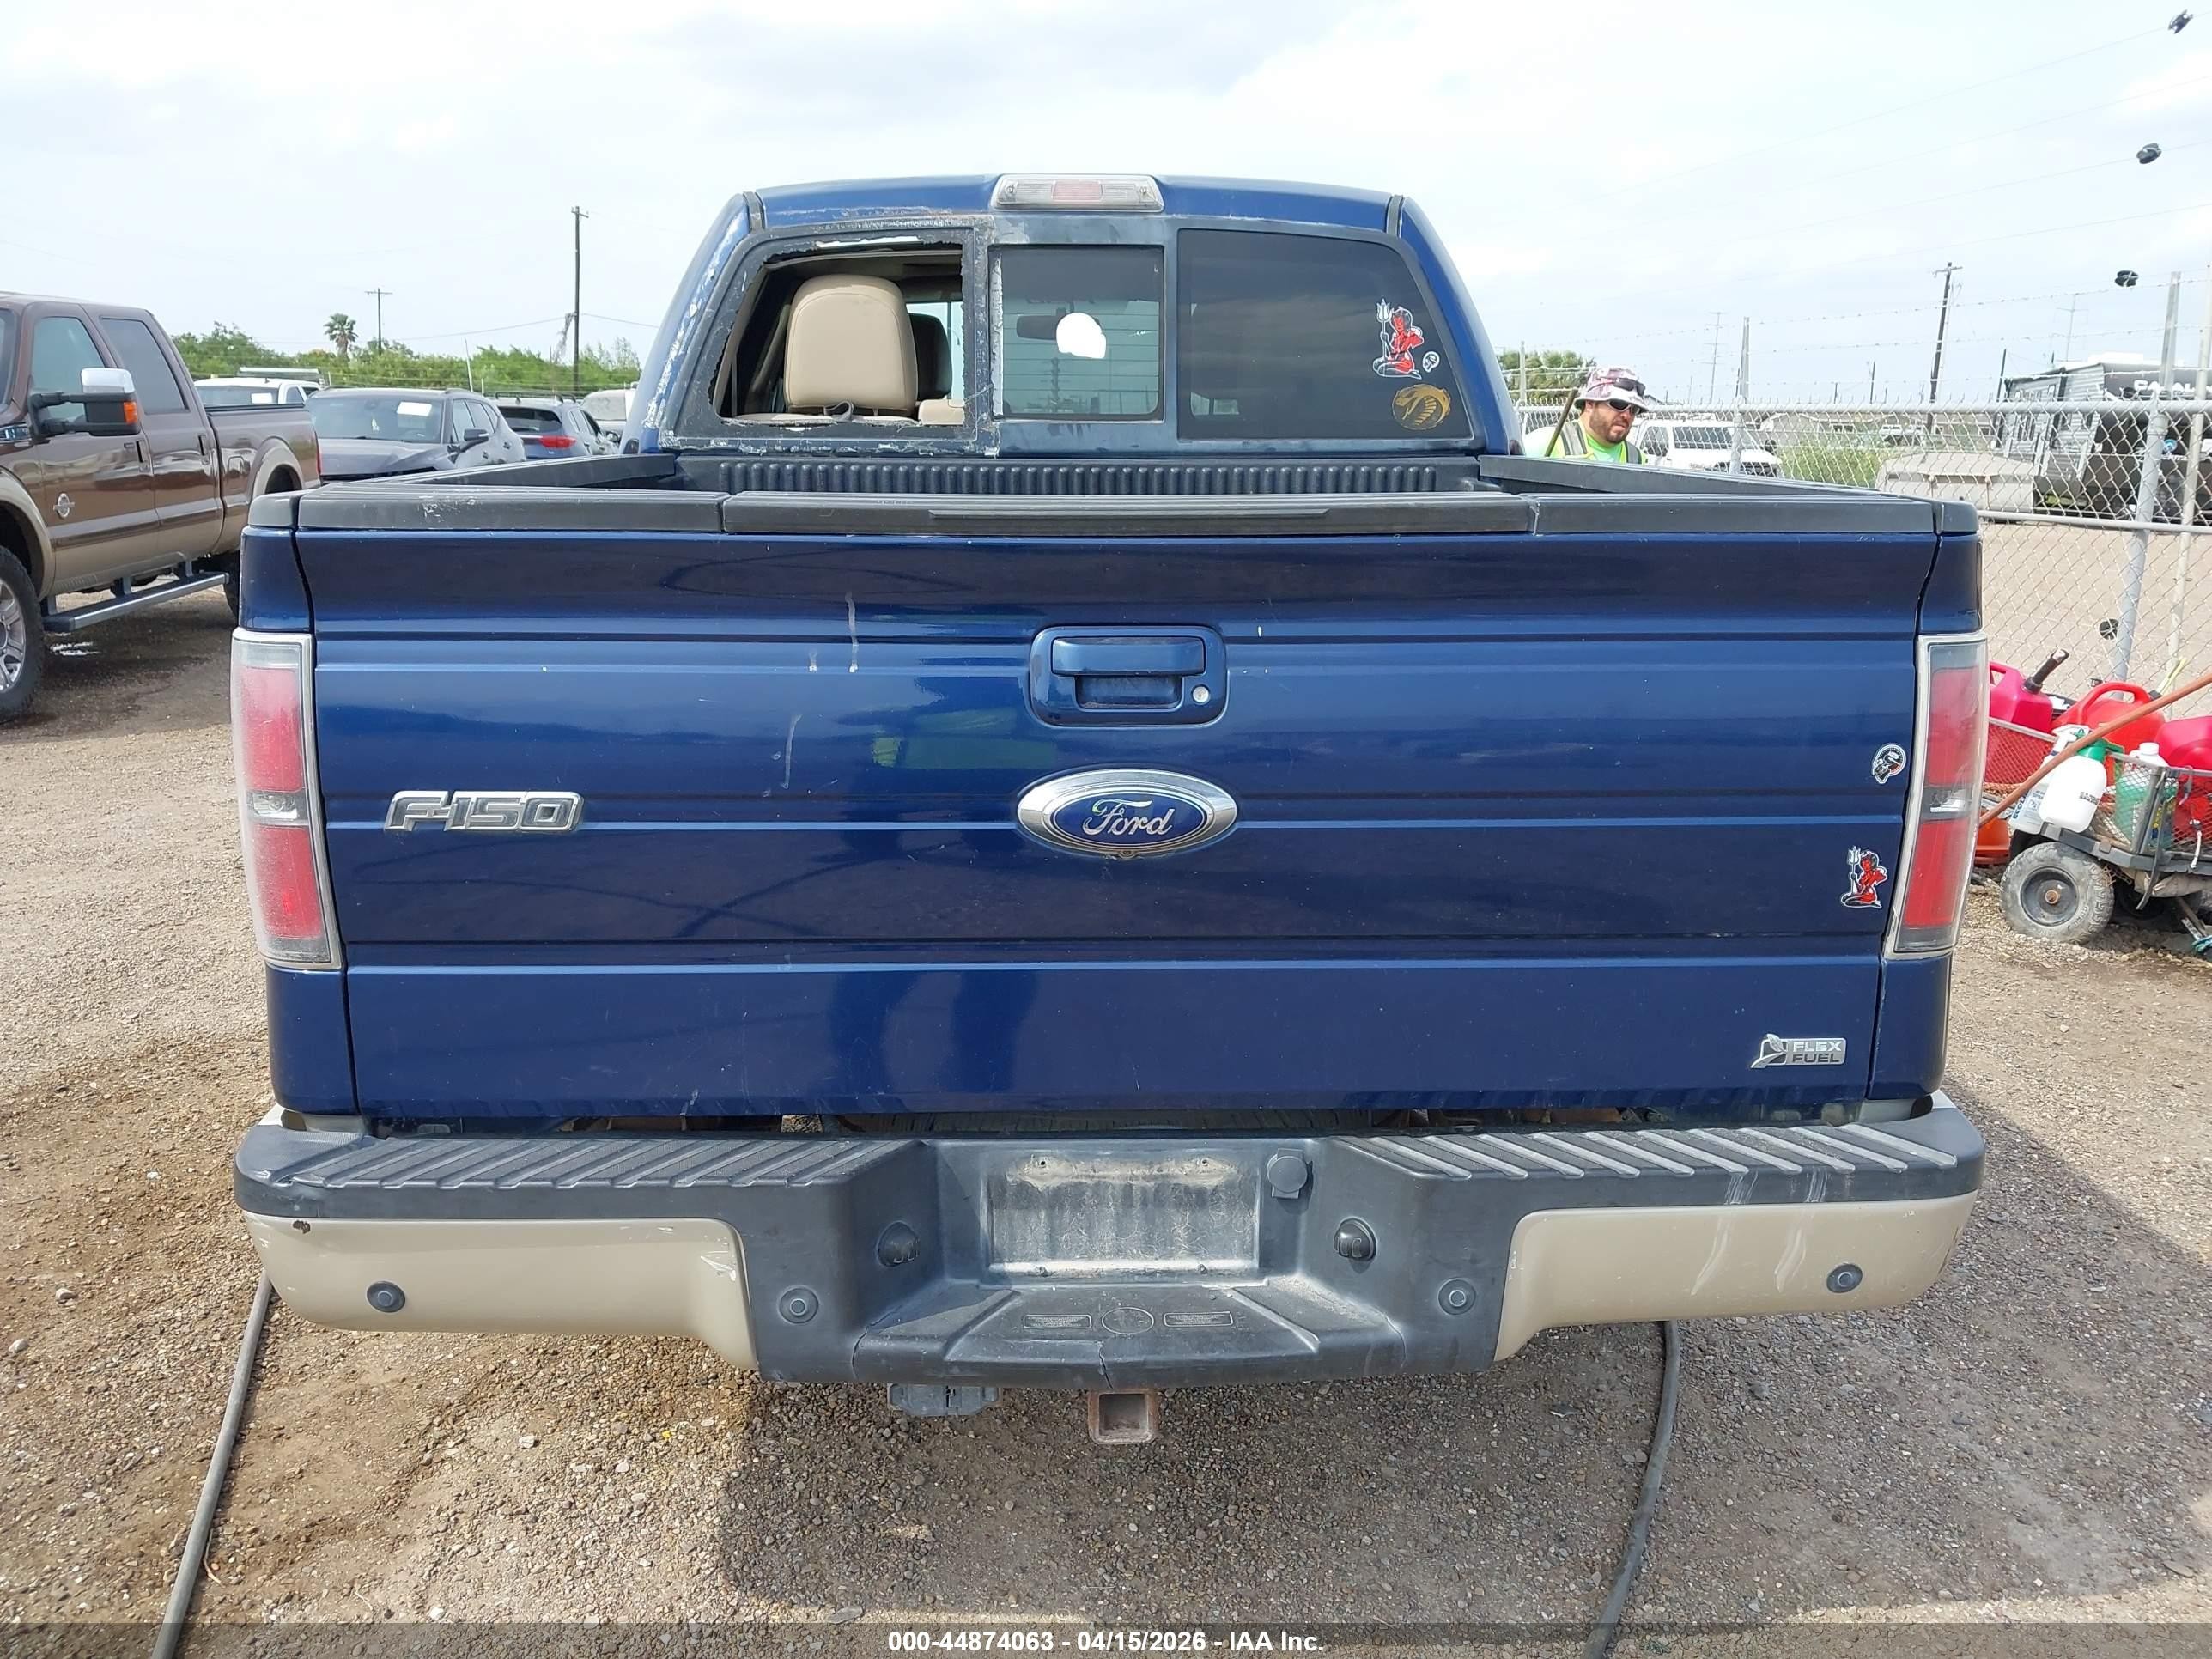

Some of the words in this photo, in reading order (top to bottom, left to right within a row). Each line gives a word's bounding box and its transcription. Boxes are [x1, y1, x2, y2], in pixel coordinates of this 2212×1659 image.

[385, 790, 585, 832] F-150
[1082, 798, 1176, 836] Ford
[1791, 1053, 1840, 1063] FUEL
[1792, 1041, 1842, 1053] FLEX
